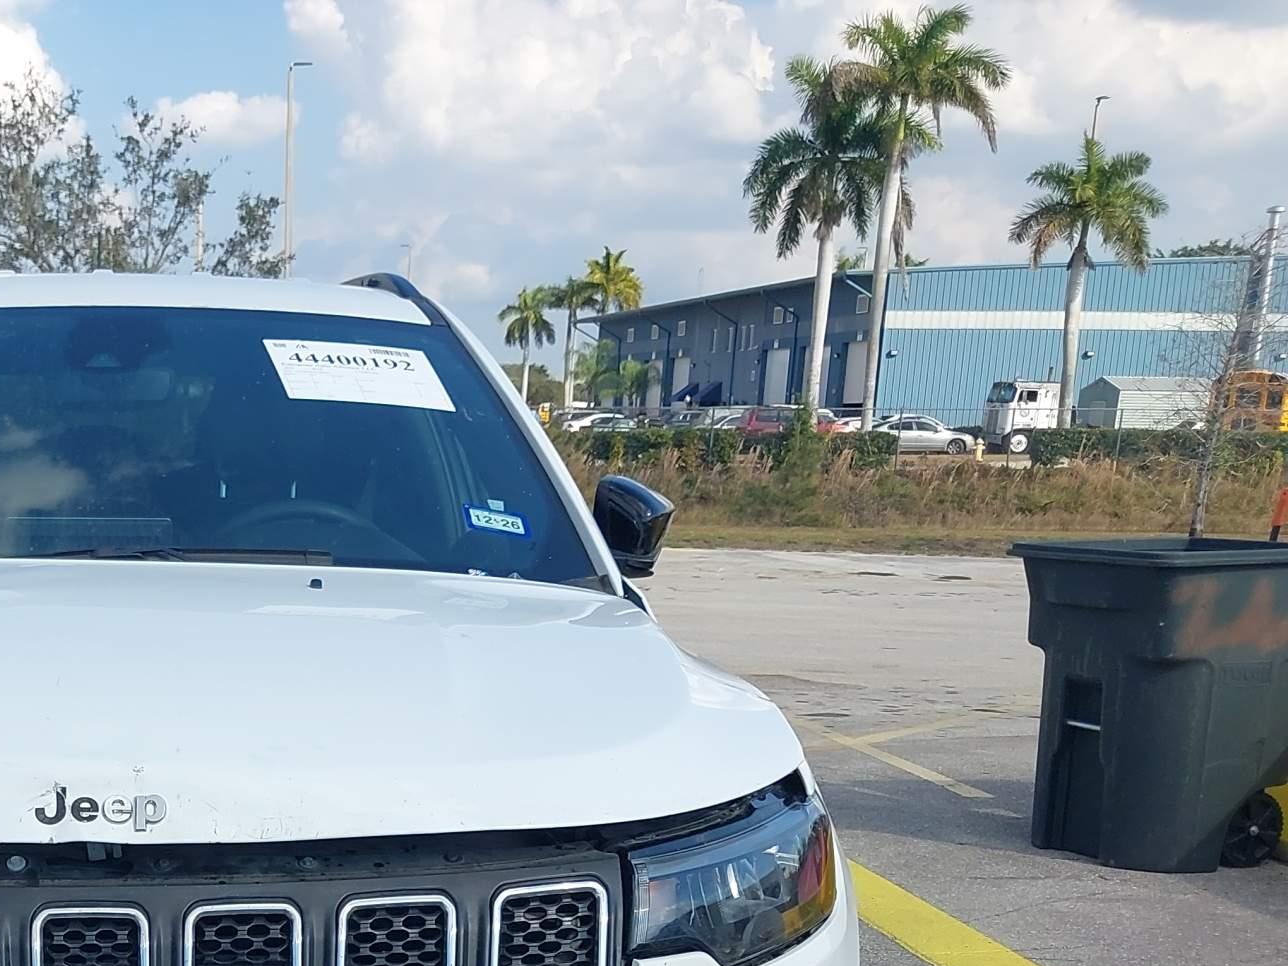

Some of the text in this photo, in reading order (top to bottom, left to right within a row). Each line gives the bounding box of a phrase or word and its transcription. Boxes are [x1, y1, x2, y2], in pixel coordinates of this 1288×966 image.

[288, 352, 416, 372] 44400192
[474, 514, 521, 530] 12 26
[34, 786, 167, 832] Jeep
